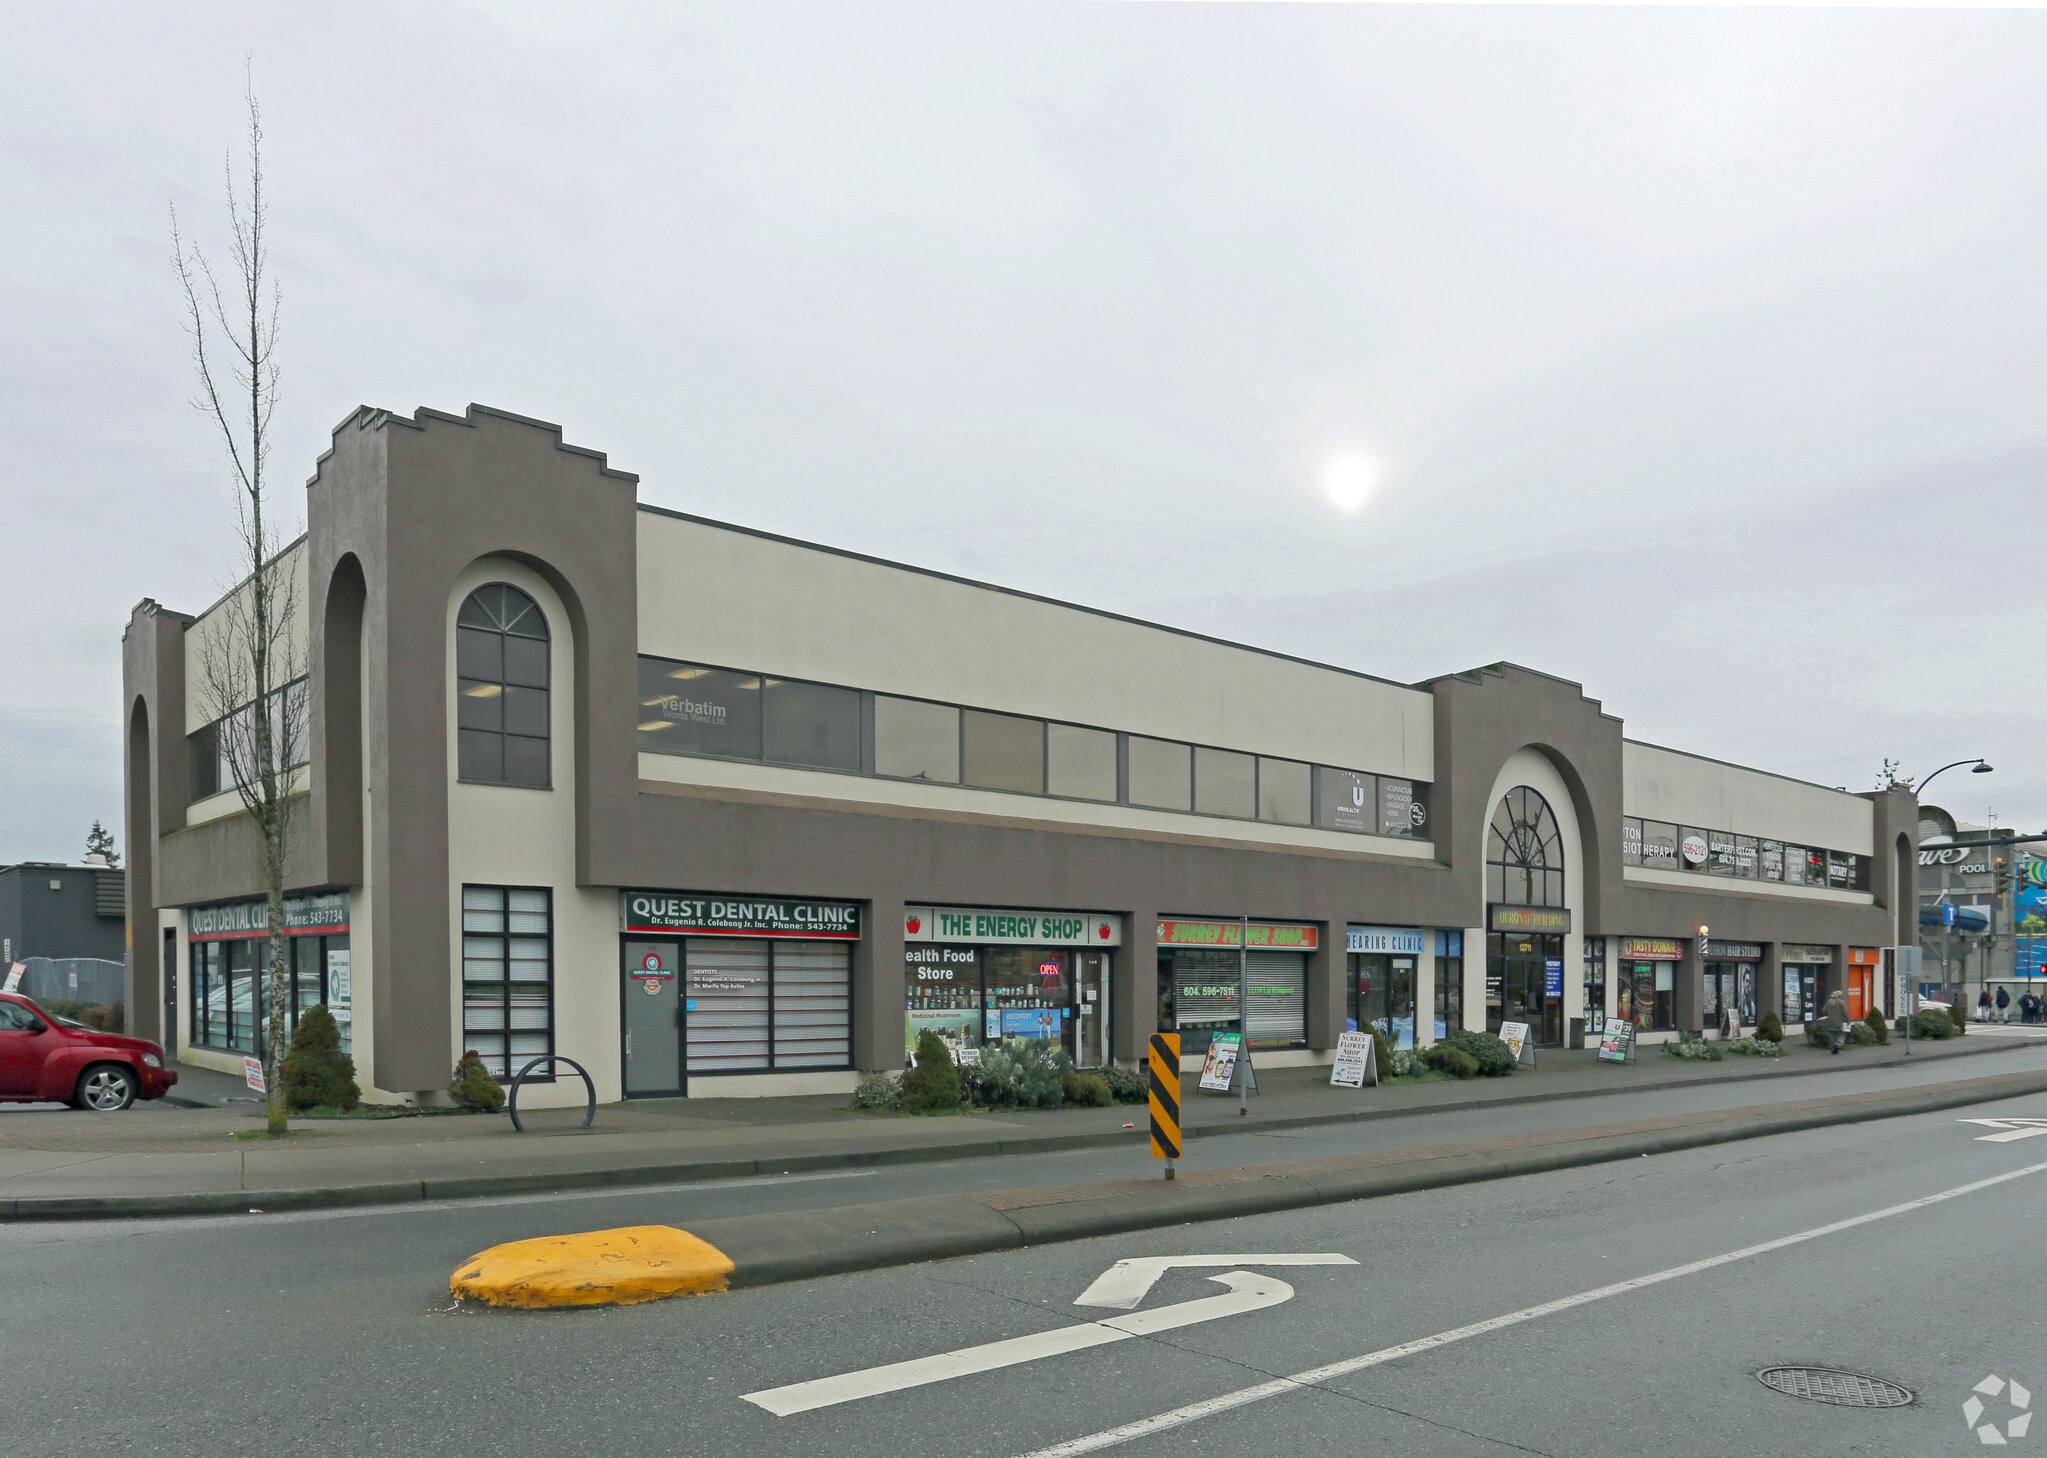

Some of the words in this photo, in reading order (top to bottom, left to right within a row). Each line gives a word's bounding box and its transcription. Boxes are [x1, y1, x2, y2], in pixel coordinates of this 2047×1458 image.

[663, 709, 689, 721] Words
[690, 712, 710, 724] West
[1623, 826, 1641, 840] TON
[1623, 841, 1675, 859] SIOTHERAPY
[1959, 864, 1986, 873] POOL
[632, 898, 705, 918] QUEST
[711, 901, 789, 921] DENTAL
[793, 905, 856, 923] CLINIC
[192, 908, 217, 935] QUEST
[218, 904, 250, 931] DENTAL
[251, 902, 269, 929] CLI
[285, 912, 309, 926] Phone:
[310, 910, 343, 924] 543-7734
[665, 917, 696, 926] Eugenio
[698, 918, 706, 926] R.
[708, 918, 742, 929] Colobong
[744, 920, 753, 928] Jr.
[755, 920, 768, 929] Inc.
[772, 921, 803, 930] Phone:
[807, 922, 847, 931] 543-7734
[941, 914, 971, 936] THE
[976, 915, 1037, 938] ENERGY
[1042, 917, 1083, 939] SHOP
[1171, 923, 1221, 943] SURREY
[1271, 928, 1304, 946] SHOP
[1392, 936, 1422, 951] CLINIC
[1632, 940, 1651, 953] TASTY
[1652, 940, 1676, 953] DONAIR
[905, 949, 939, 962] ealth
[943, 949, 974, 963] Food
[1727, 945, 1741, 956] HAIR
[1741, 946, 1761, 957] STUDIO
[917, 967, 953, 980] Store
[1040, 963, 1059, 975] OPEN
[1899, 976, 1907, 1015] PHONES
[1340, 1041, 1366, 1049] FLOWER
[1341, 1034, 1366, 1043] SURREY
[1343, 1048, 1360, 1056] SHOP
